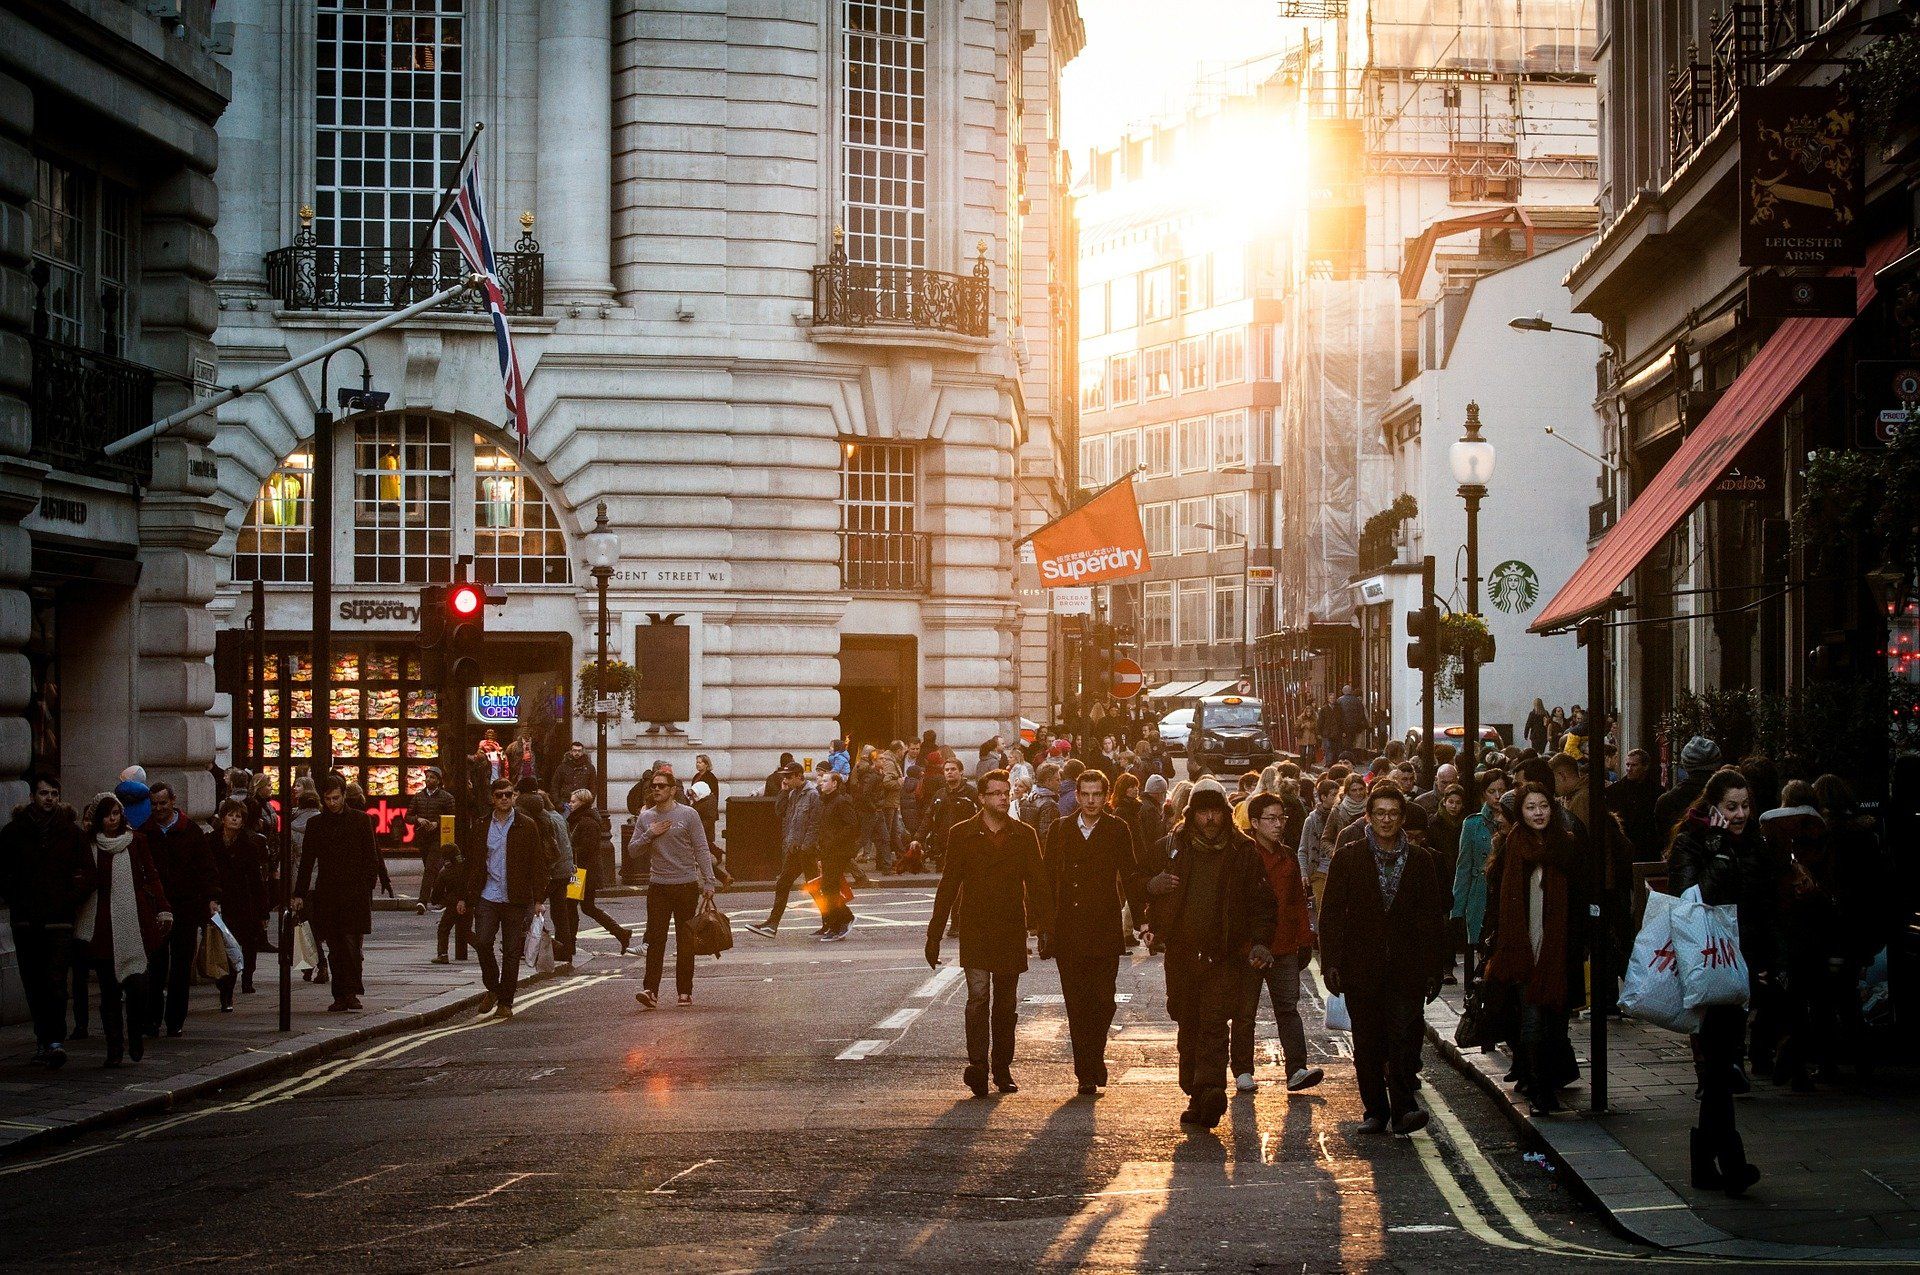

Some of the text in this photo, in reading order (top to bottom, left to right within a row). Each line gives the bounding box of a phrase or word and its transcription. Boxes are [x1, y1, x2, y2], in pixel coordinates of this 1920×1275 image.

[1764, 237, 1842, 248] LEICESTER
[1784, 251, 1825, 261] ARMS
[1041, 546, 1143, 580] Superdry
[610, 571, 648, 581] GENT
[658, 571, 701, 581] STREET
[340, 601, 421, 624] Superdry
[1701, 934, 1739, 971] H&M
